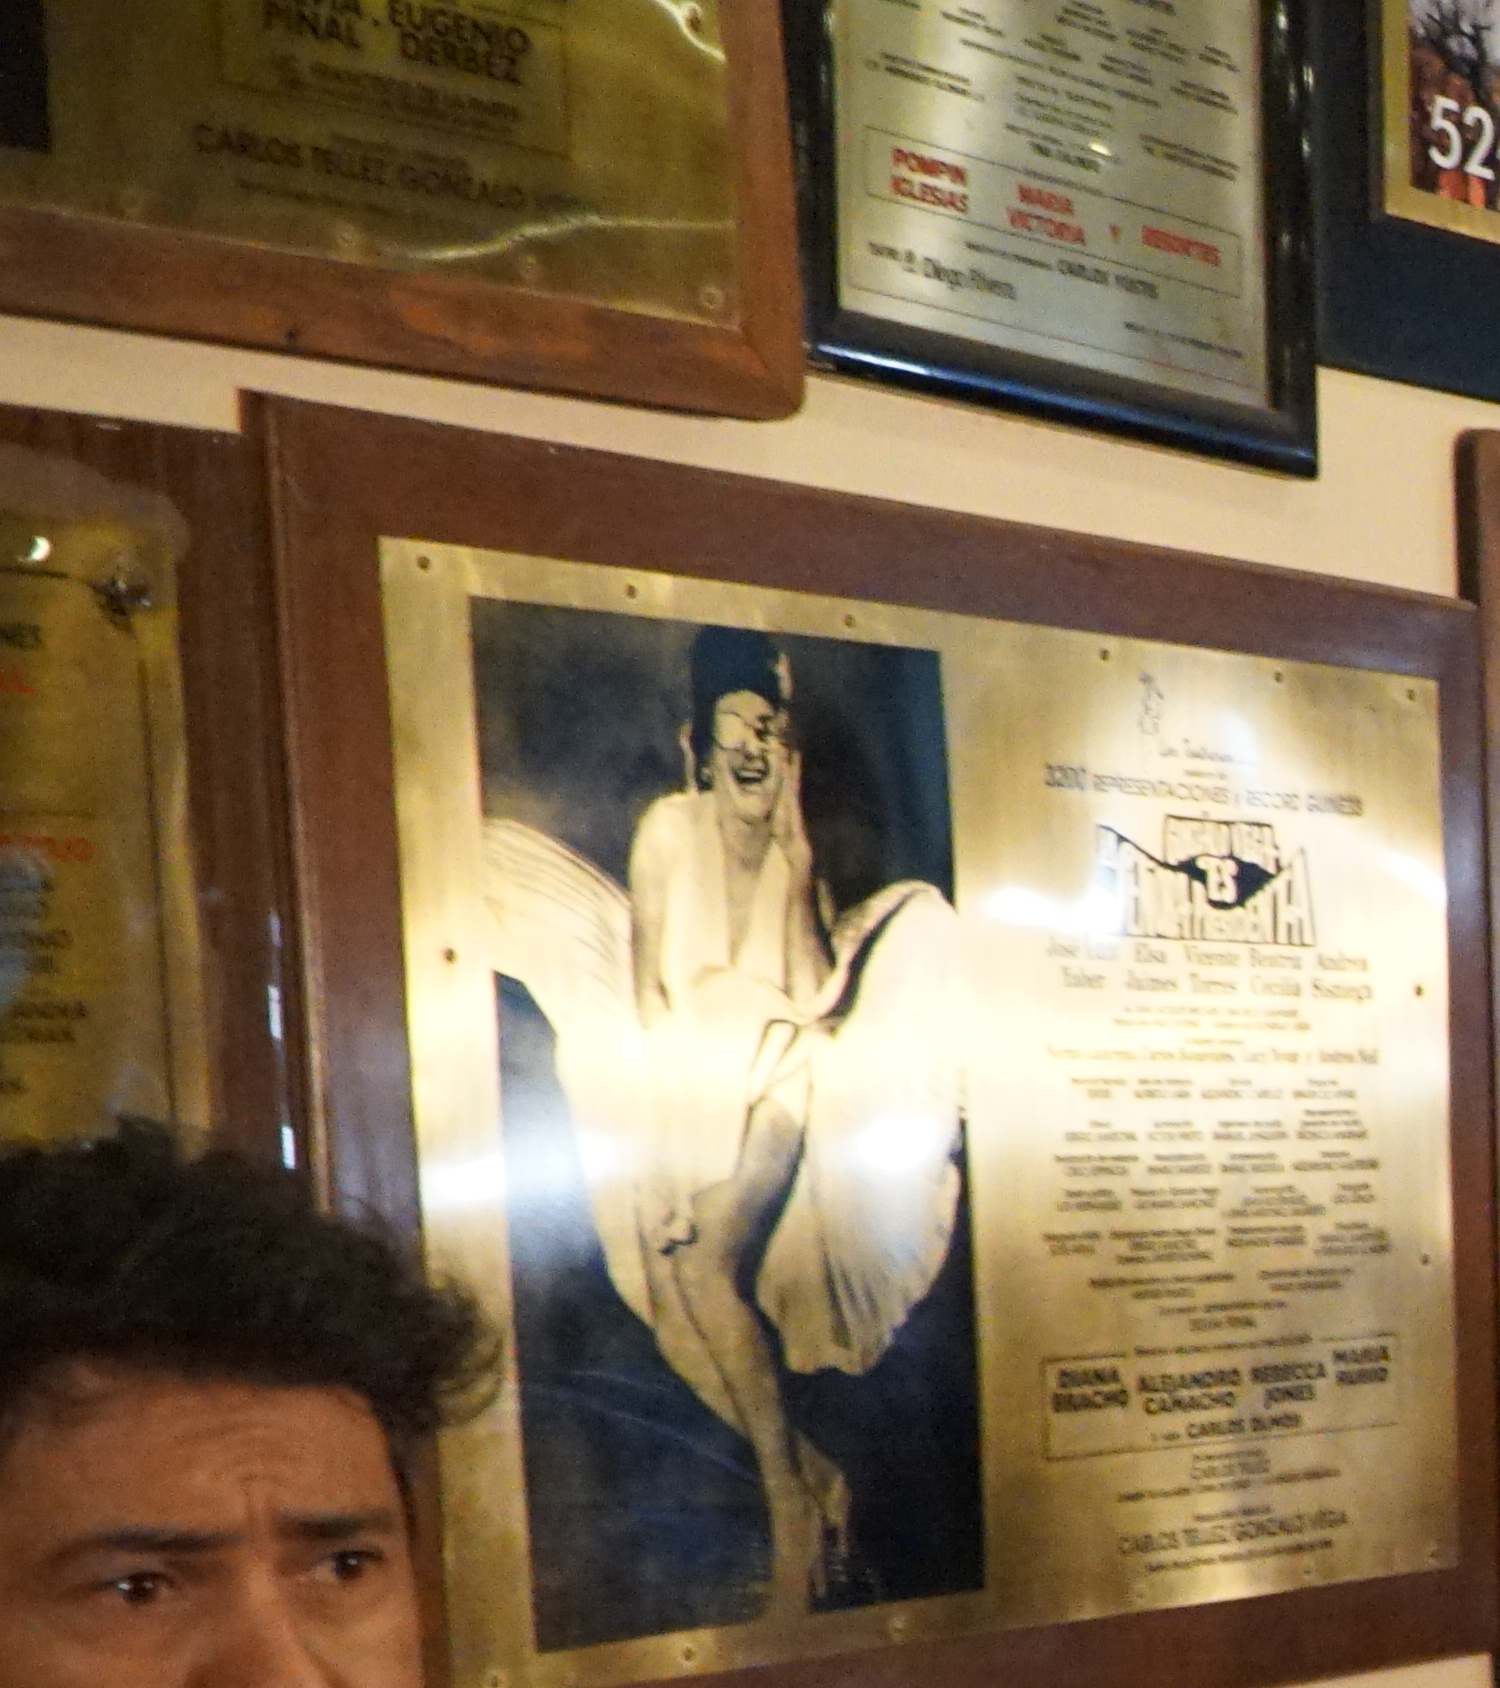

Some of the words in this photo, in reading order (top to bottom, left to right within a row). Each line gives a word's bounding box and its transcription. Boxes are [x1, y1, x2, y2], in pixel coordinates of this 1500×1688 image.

[387, 0, 533, 56] EUGENIO
[400, 32, 522, 85] DERBEZ
[1428, 95, 1495, 181] 52
[891, 175, 970, 214] IGLESIAS
[1006, 207, 1087, 247] VICTORIA
[1092, 773, 1230, 806] REPRESENTACIONES
[1058, 1367, 1120, 1390] DIANA
[1137, 1367, 1243, 1394] ALEJANDRO
[1250, 1362, 1327, 1385] REBECCA
[1052, 1390, 1129, 1414] BRACHO
[1145, 1391, 1236, 1415] CAMACHO
[1264, 1385, 1316, 1411] JONES
[1186, 1416, 1246, 1439] CARLOS
[1118, 1531, 1181, 1556] CARLOS
